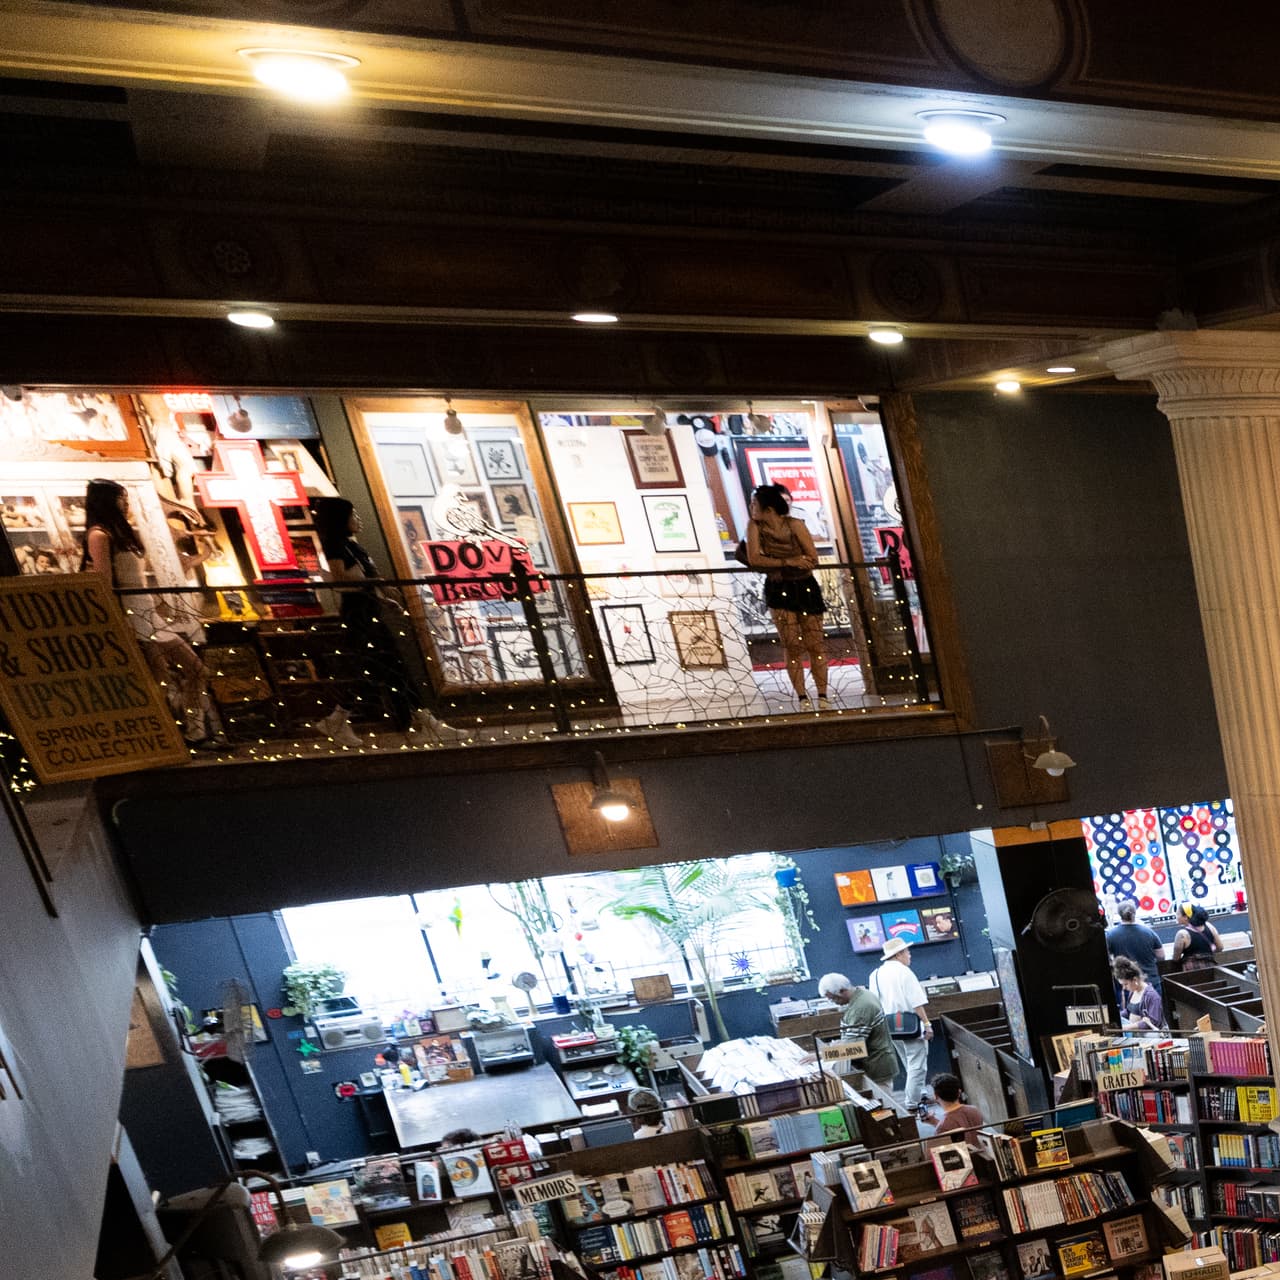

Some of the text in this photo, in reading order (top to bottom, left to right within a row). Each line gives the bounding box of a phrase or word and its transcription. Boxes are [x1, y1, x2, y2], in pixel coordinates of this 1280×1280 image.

[26, 631, 129, 675] SHOPS
[13, 672, 149, 720] UPSTAIRS
[36, 716, 161, 747] SPRING ARTS
[46, 734, 170, 766] COLLECTIVE
[1075, 1011, 1100, 1023] MUSIC
[1103, 1072, 1137, 1089] CRAFTS
[518, 1177, 577, 1204] MEMOIRS
[1185, 1267, 1220, 1280] U-HAUL
